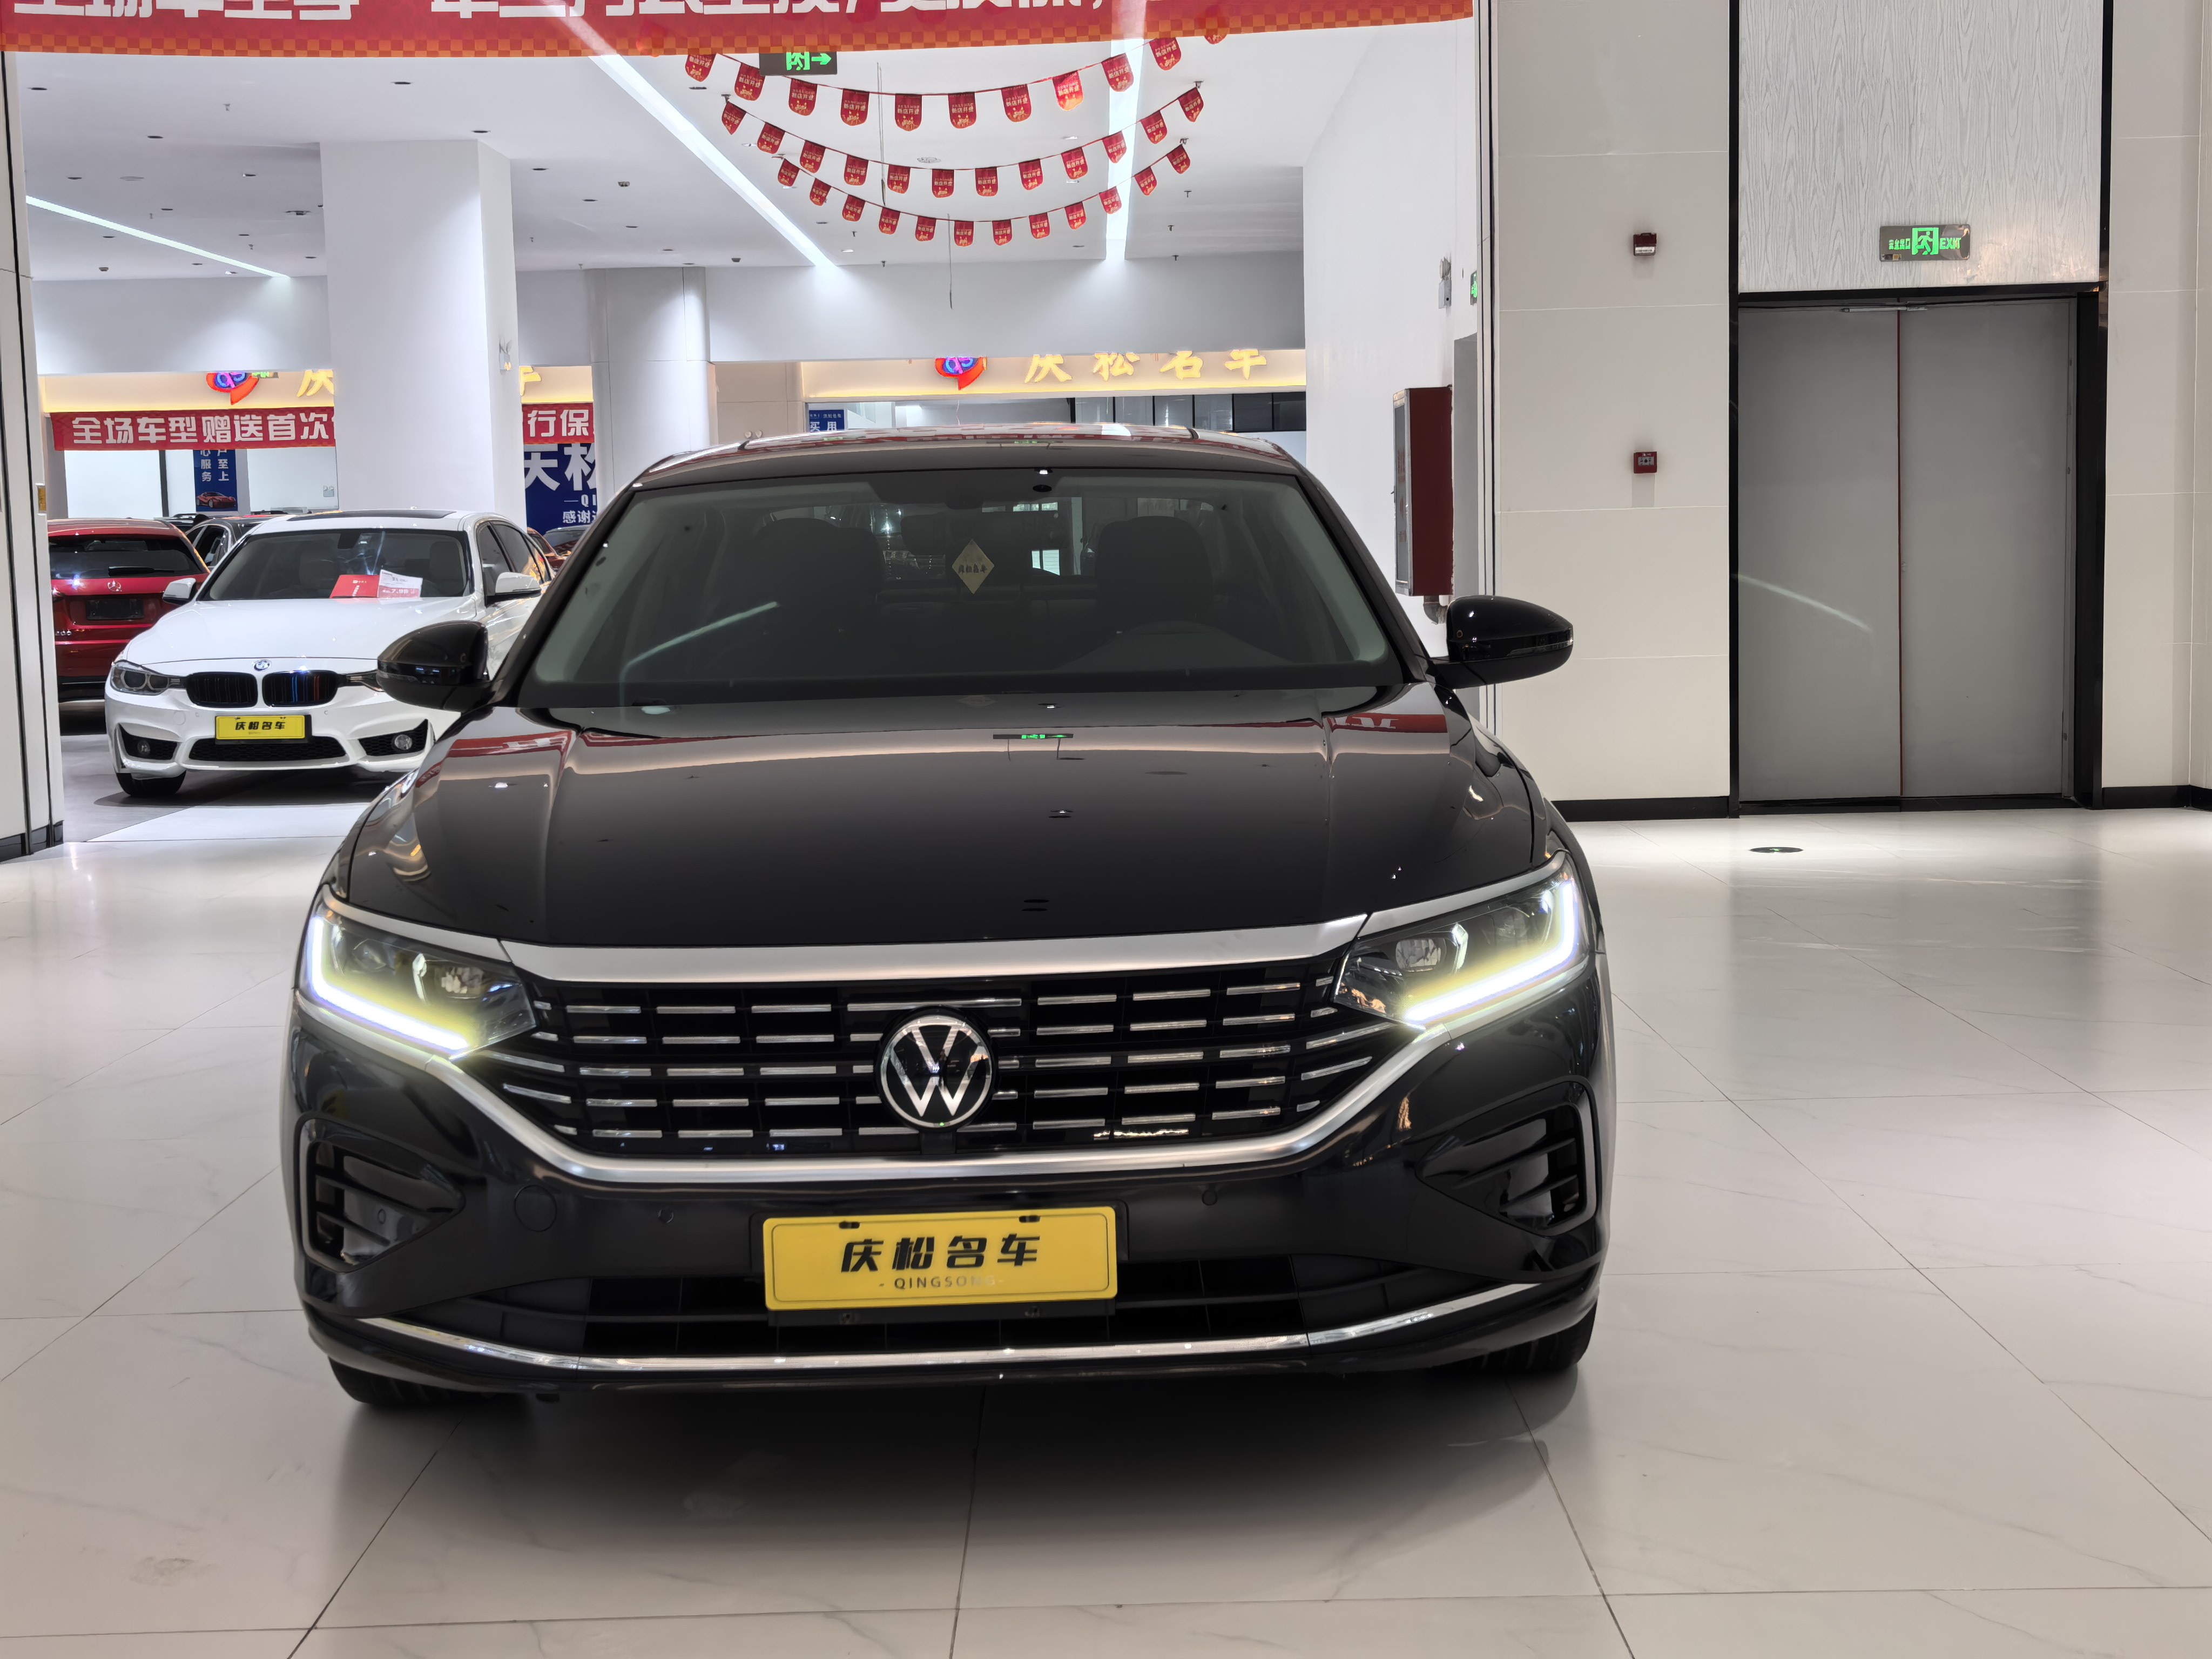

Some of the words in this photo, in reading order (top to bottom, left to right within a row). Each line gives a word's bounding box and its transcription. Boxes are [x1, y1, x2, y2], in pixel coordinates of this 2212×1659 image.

[1939, 238, 1961, 249] EXIT
[72, 413, 334, 444] 全场车型赠送首次
[563, 510, 596, 524] 感谢
[235, 721, 286, 730] 庆松名车
[840, 1233, 1041, 1273] 庆松名车
